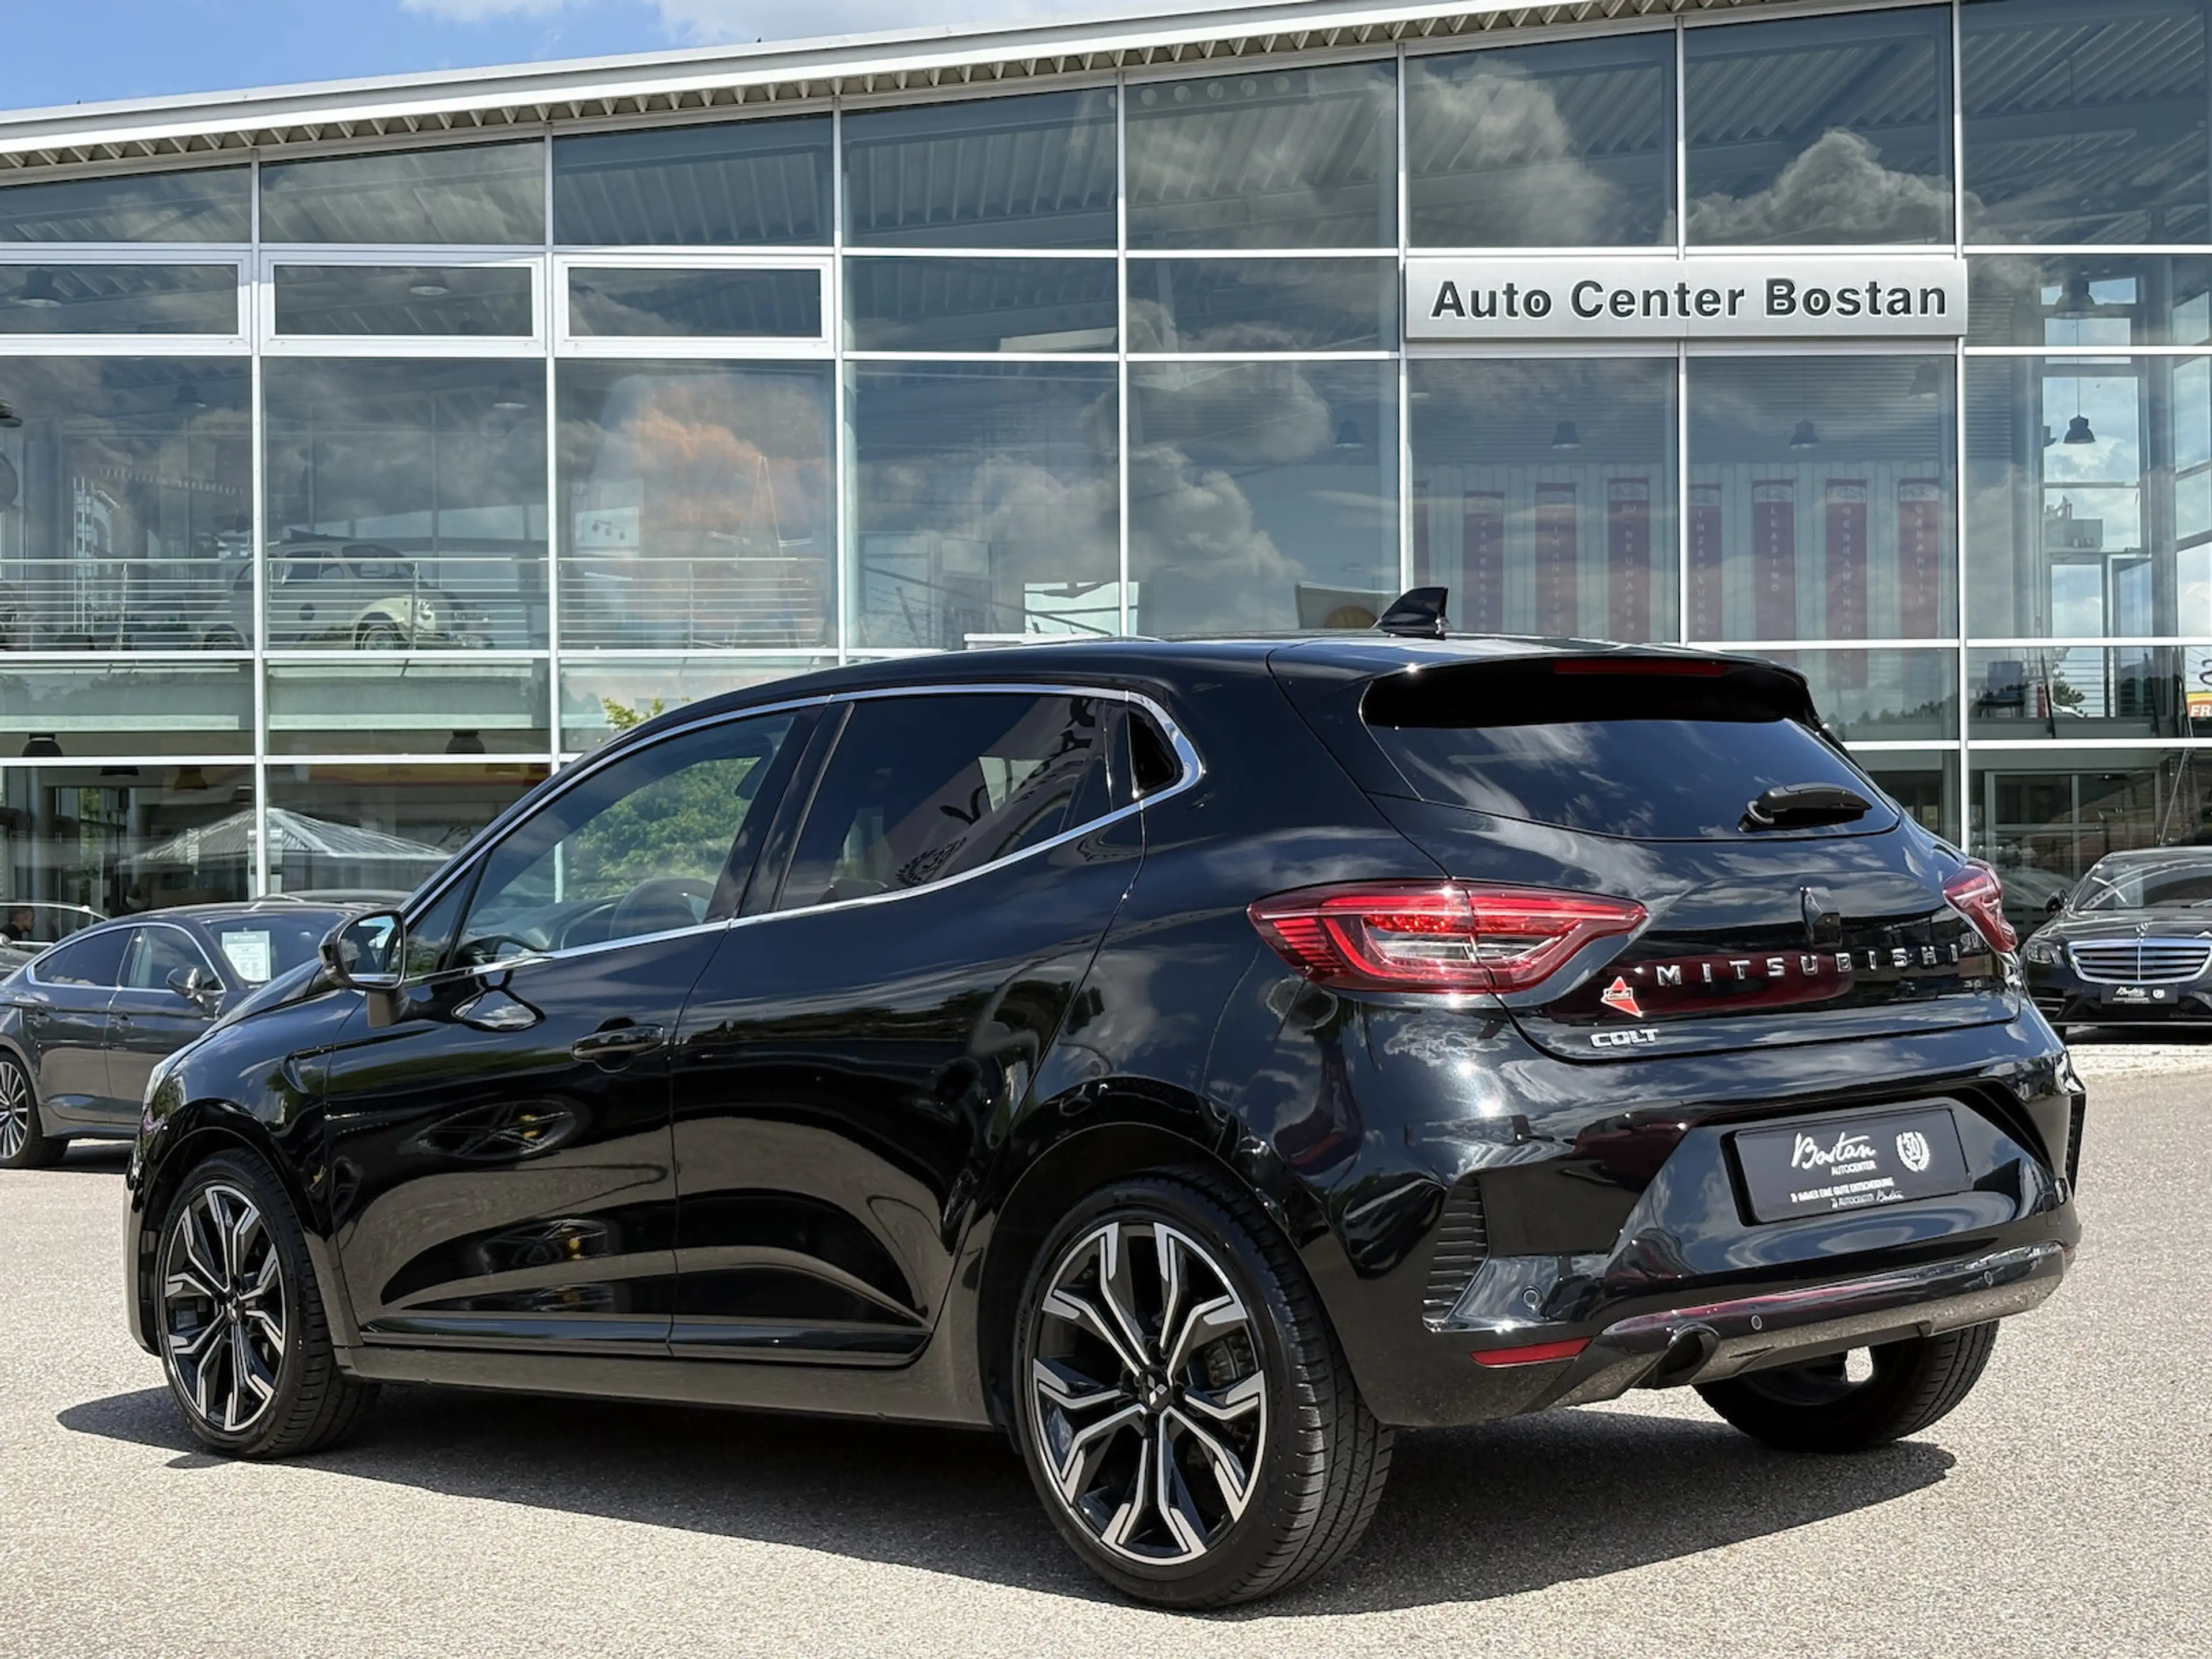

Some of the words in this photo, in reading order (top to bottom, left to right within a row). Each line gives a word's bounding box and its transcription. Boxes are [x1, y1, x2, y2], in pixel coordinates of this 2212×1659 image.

[1431, 280, 1552, 319] Auto
[1570, 279, 1745, 318] Center
[1765, 278, 1946, 317] Bostan
[2190, 704, 2212, 717] FR
[1656, 944, 1958, 986] MITSUBISHI
[1590, 1028, 1658, 1048] COLT
[1791, 1132, 1876, 1169] Bostan
[1831, 1160, 1876, 1176] AUTOCENTER
